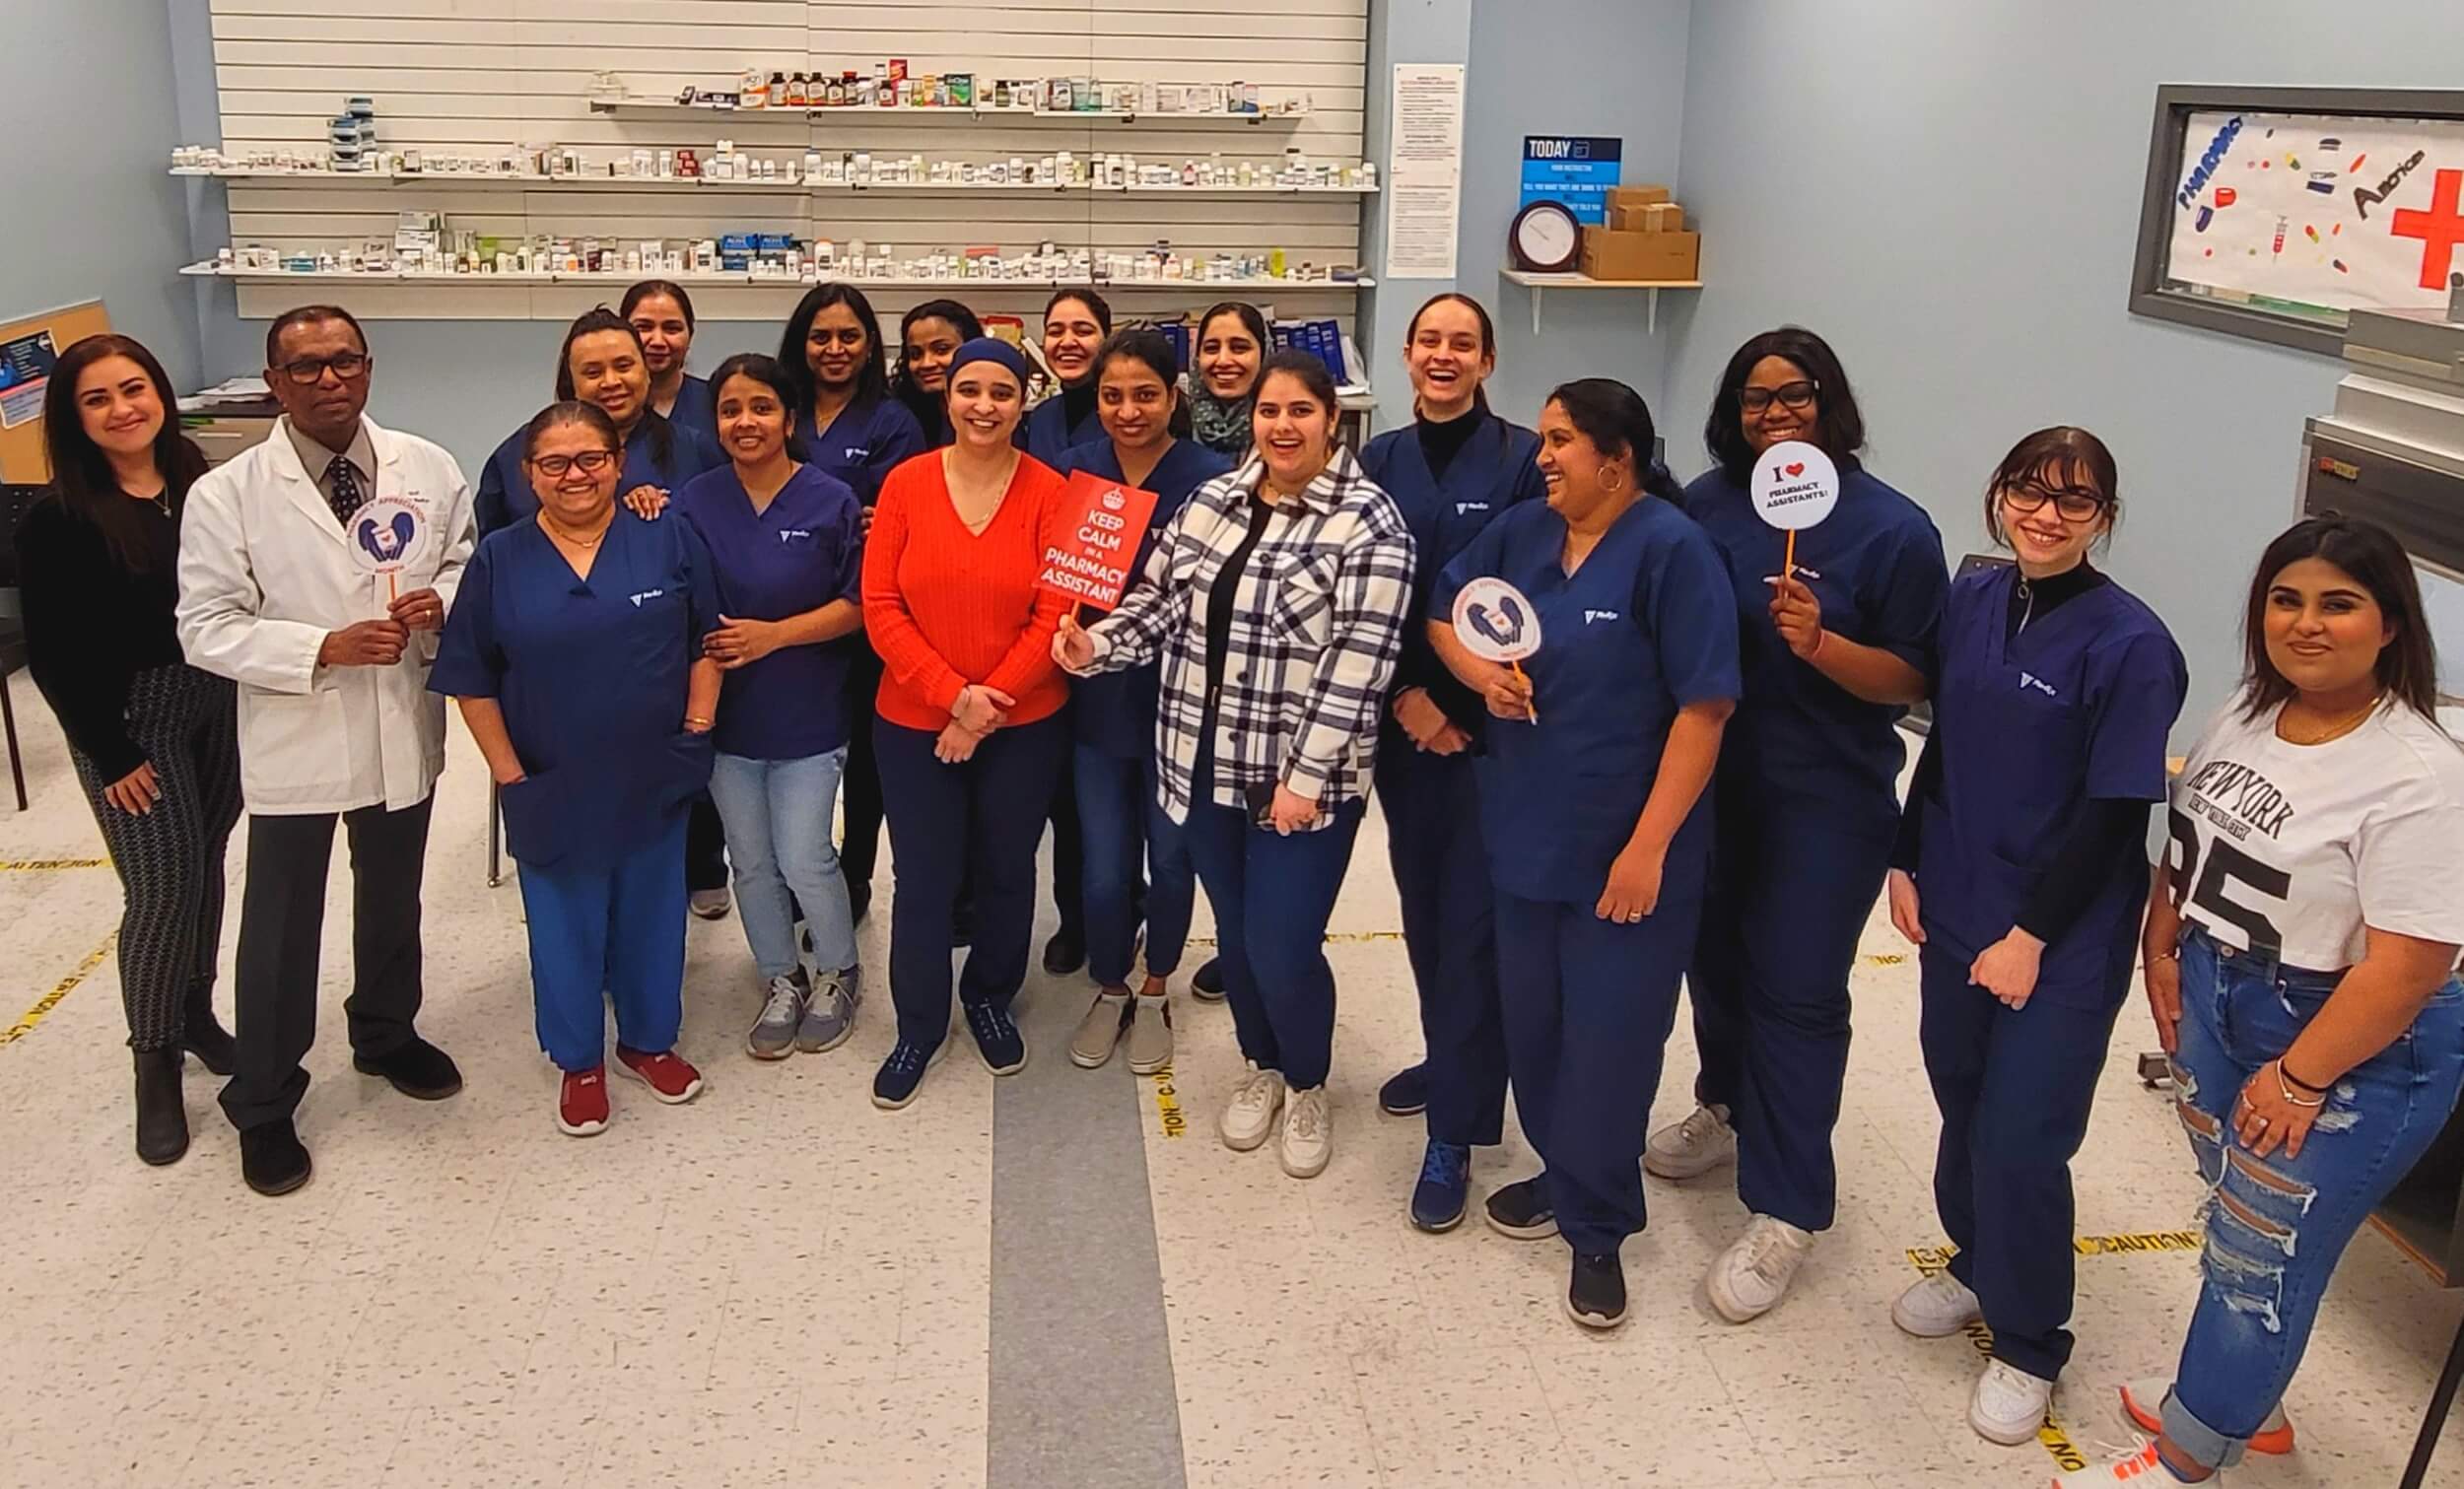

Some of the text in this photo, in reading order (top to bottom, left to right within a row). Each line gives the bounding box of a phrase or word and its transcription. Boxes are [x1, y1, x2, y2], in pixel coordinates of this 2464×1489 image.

[1529, 140, 1571, 158] TODAY
[1772, 466, 1784, 483] I
[1768, 481, 1819, 499] PHARMACY
[1087, 508, 1125, 530] KEEP
[1077, 526, 1122, 551] CALM
[1045, 547, 1129, 584] PHARMACY
[1041, 568, 1120, 603] ASSISTANT
[2101, 1231, 2199, 1252] CAUTION
